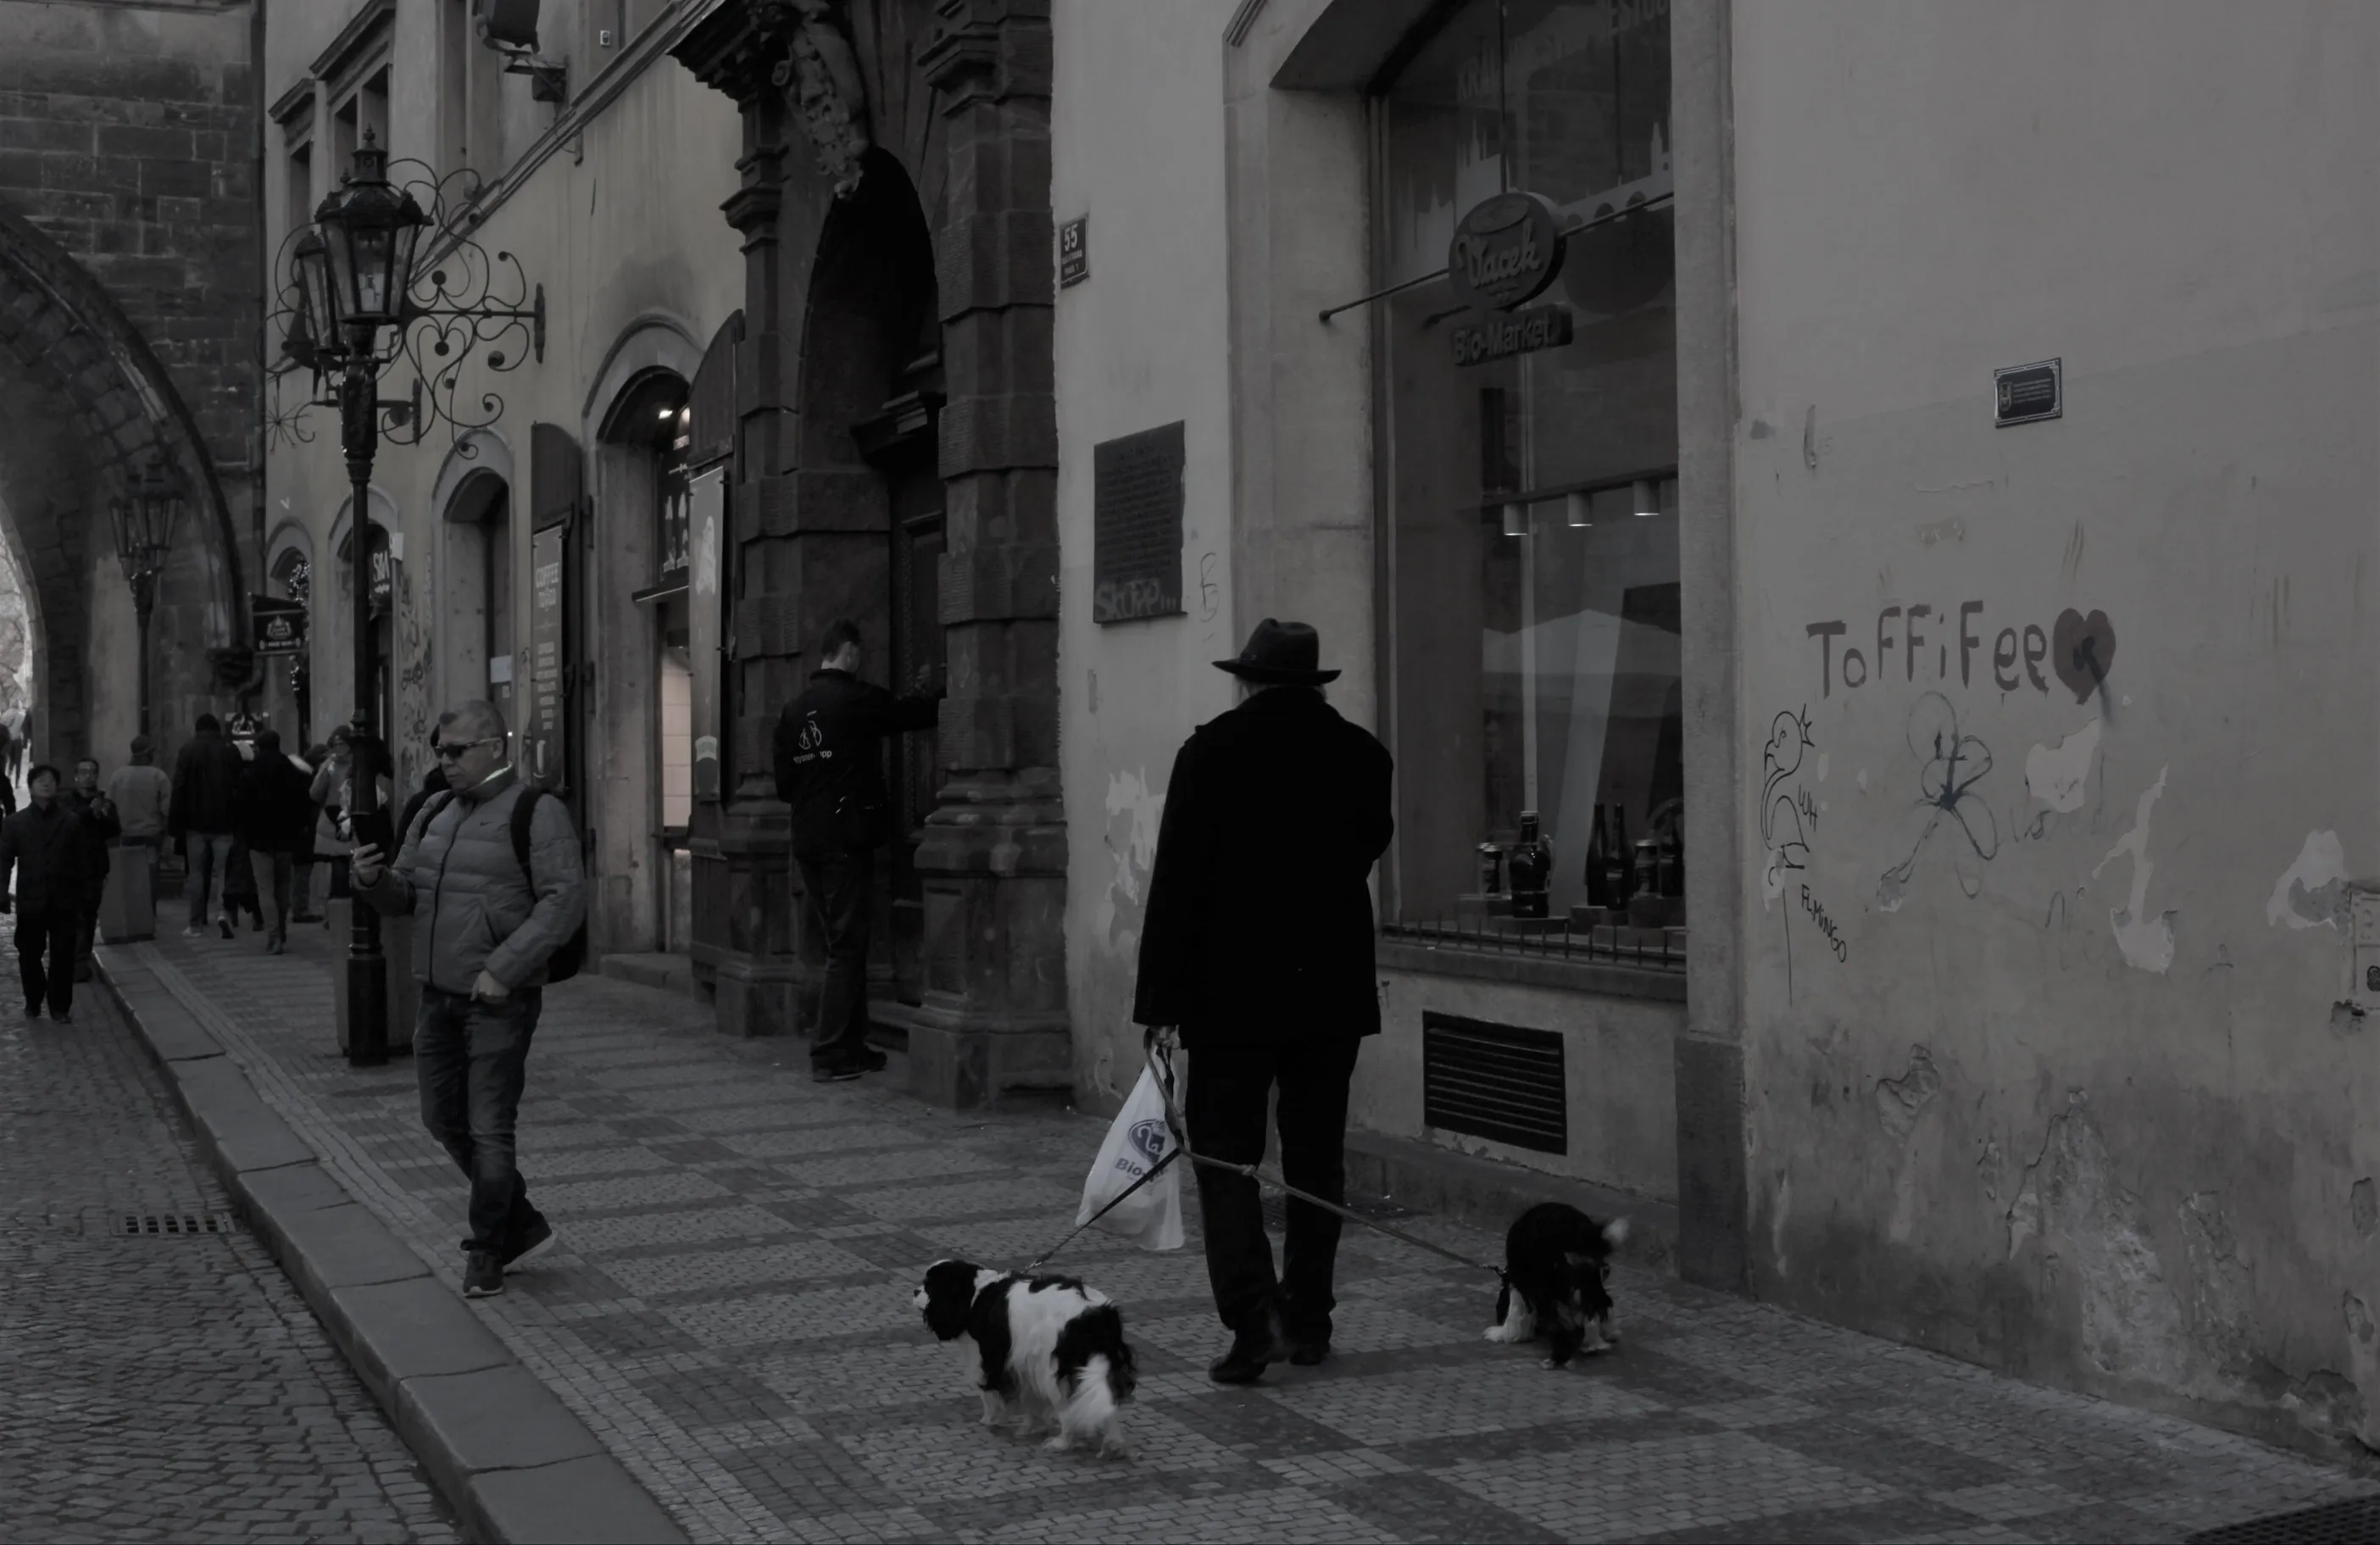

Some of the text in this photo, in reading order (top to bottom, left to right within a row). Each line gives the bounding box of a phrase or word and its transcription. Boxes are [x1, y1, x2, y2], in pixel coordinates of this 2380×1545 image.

[1065, 223, 1078, 252] 55
[1456, 218, 1542, 288] Vacek
[1454, 310, 1549, 363] Bio-Market
